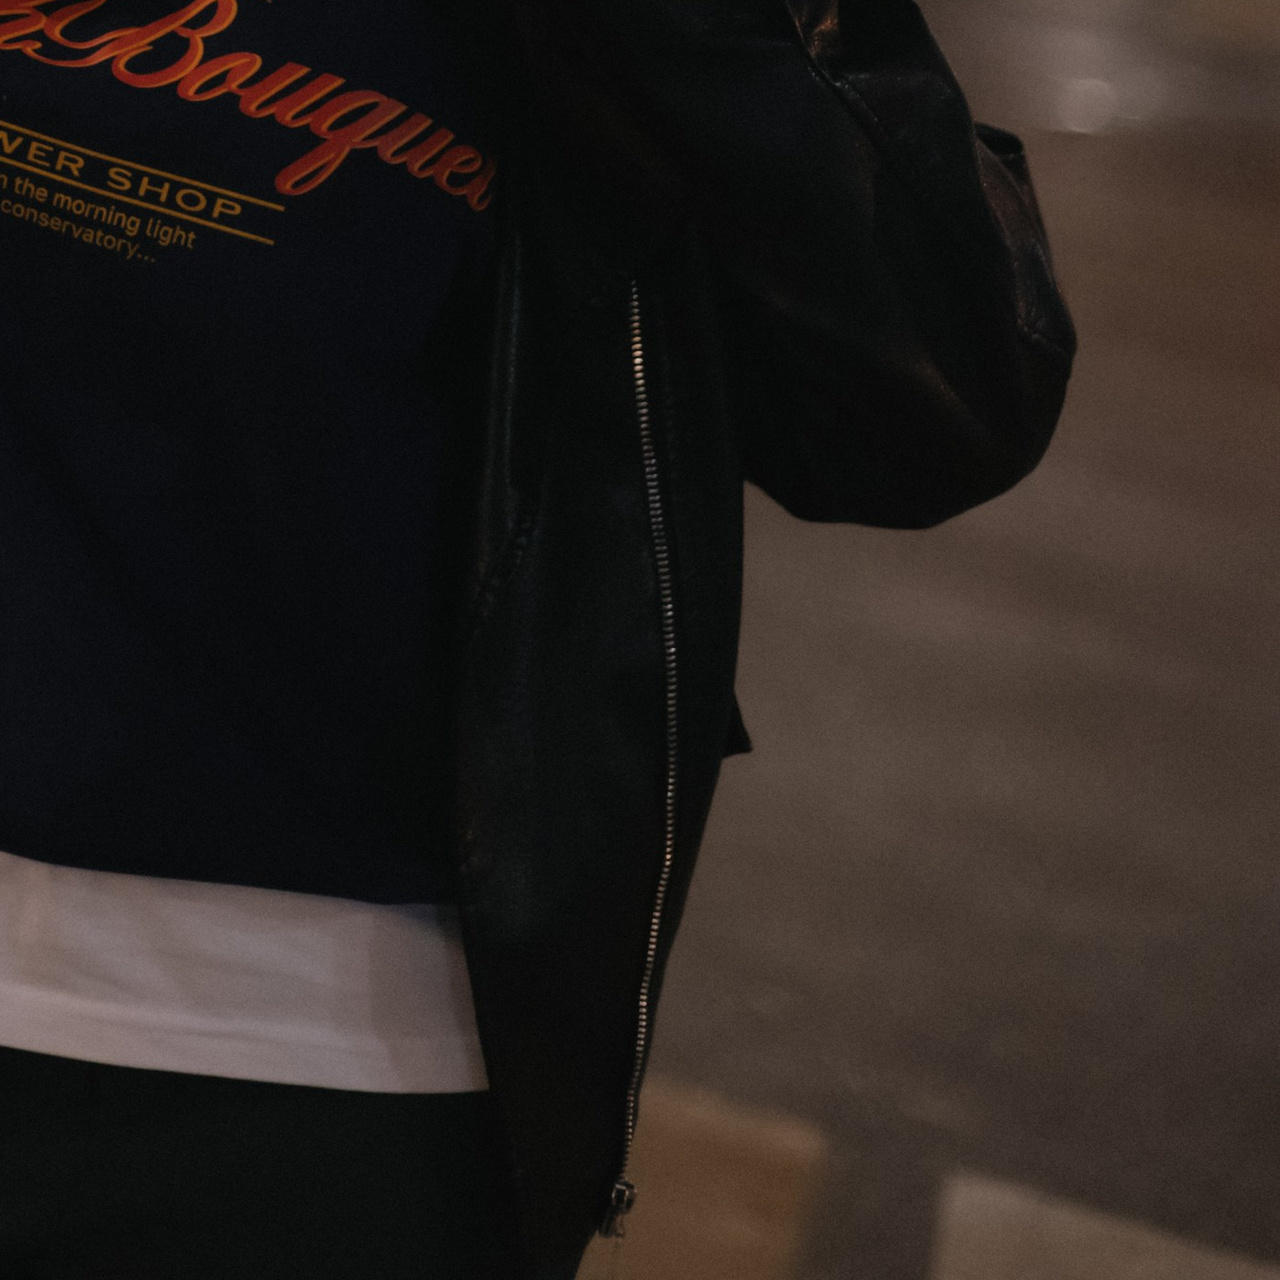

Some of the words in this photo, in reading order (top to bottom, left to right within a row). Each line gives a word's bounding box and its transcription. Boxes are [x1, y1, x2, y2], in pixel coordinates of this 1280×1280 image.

[14, 176, 48, 202] the
[53, 191, 141, 237] morning
[145, 216, 197, 250] light
[107, 167, 243, 219] SHOP
[0, 198, 157, 264] conservatory...
